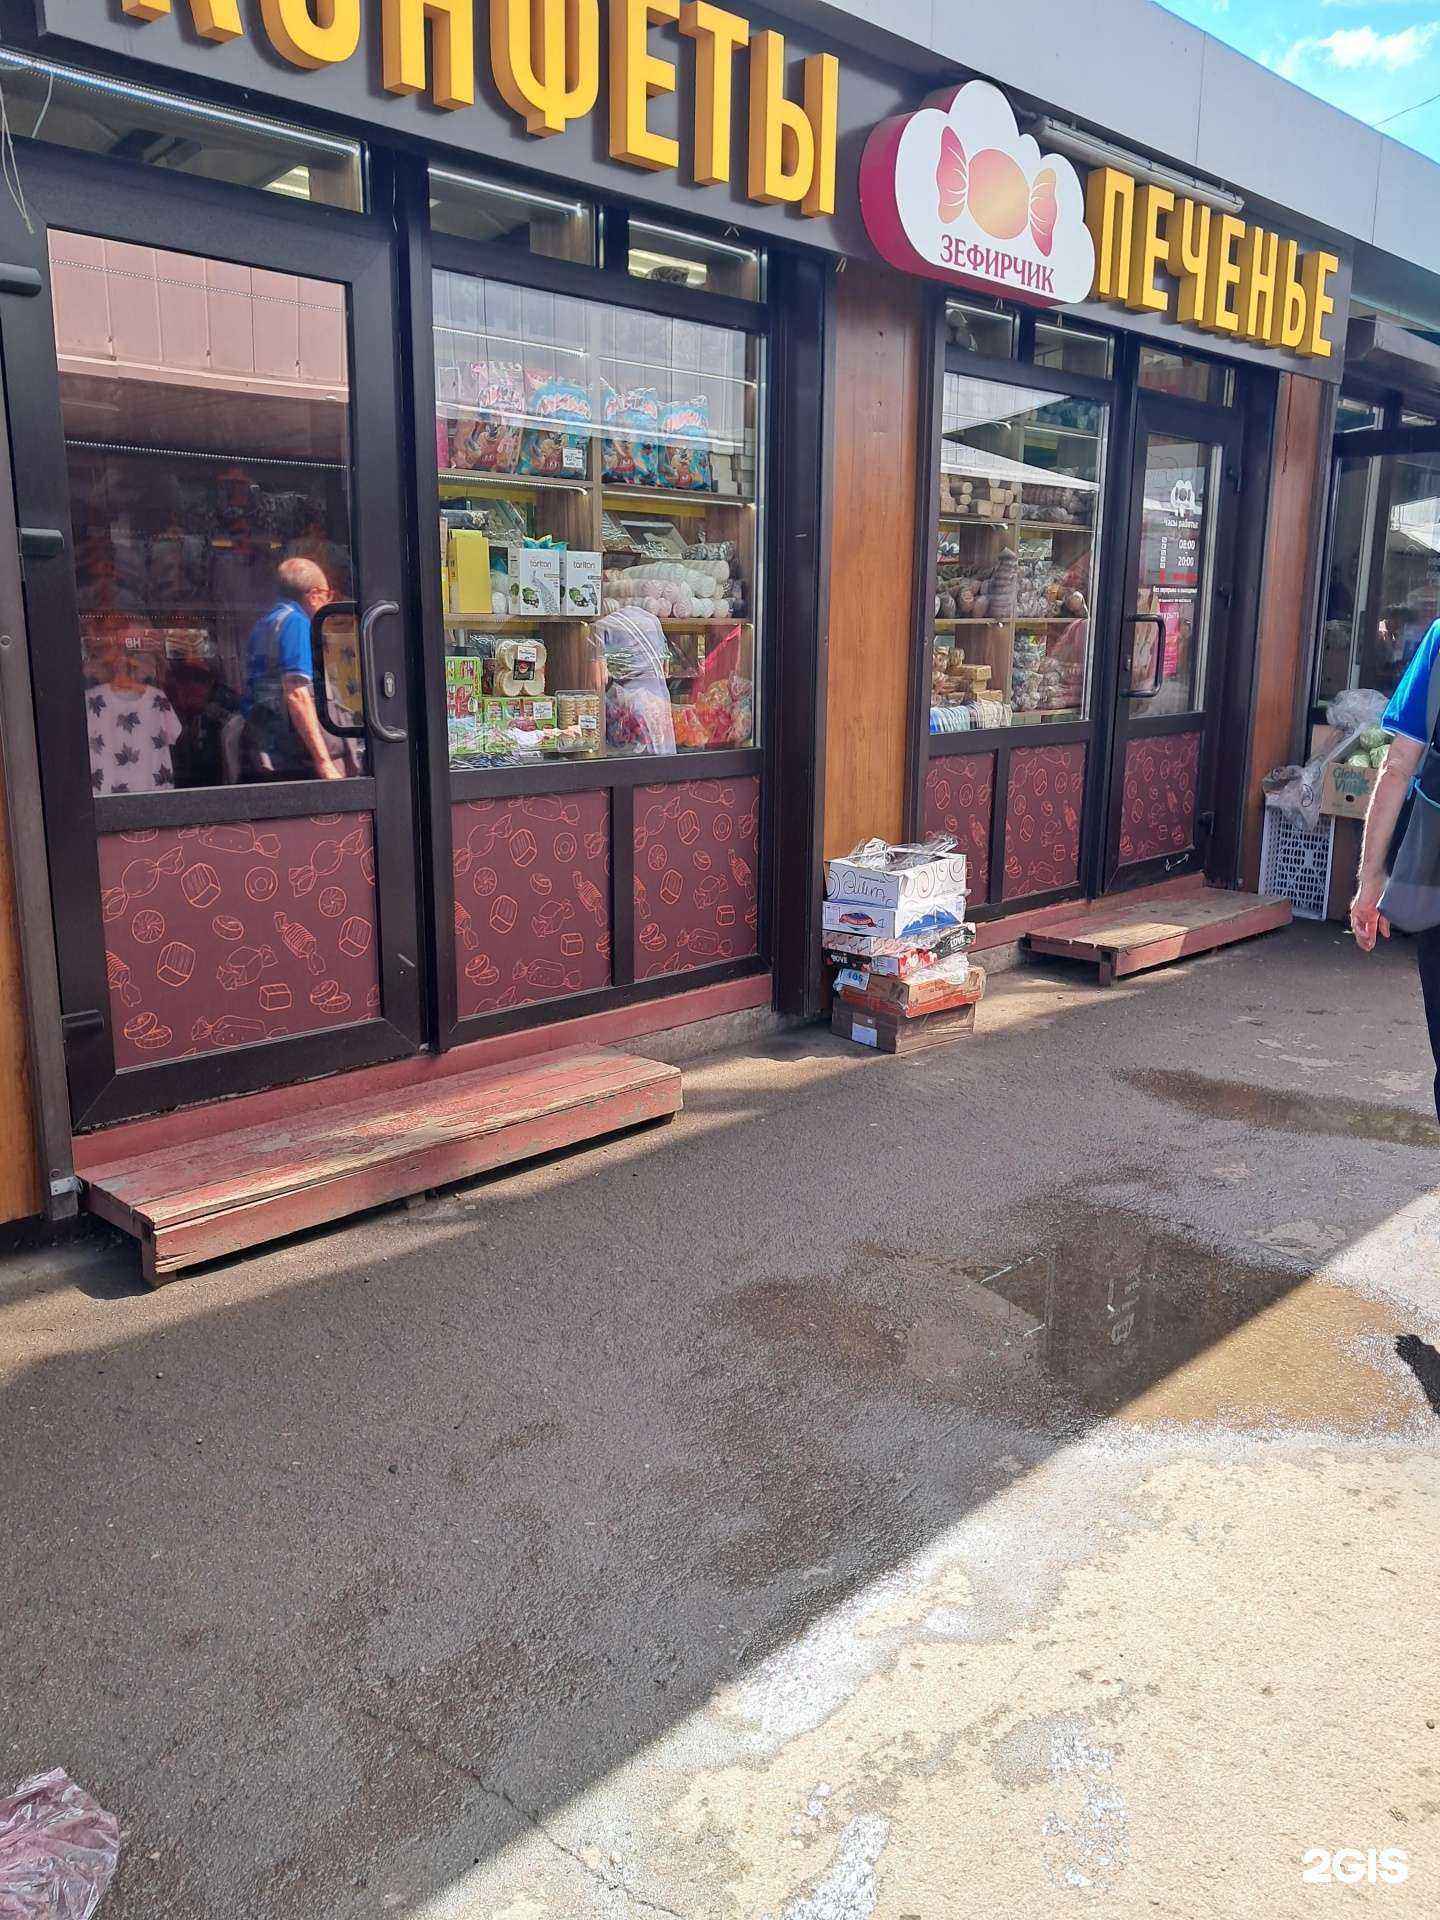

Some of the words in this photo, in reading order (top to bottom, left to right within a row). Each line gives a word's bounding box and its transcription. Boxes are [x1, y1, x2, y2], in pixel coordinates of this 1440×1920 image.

[122, 0, 840, 218] НФЕТЫ
[940, 234, 1054, 293] ЗЕФИРЧИК
[1088, 167, 1339, 359] ПЕЧЕНЬЕ
[1177, 556, 1195, 567] 20:00
